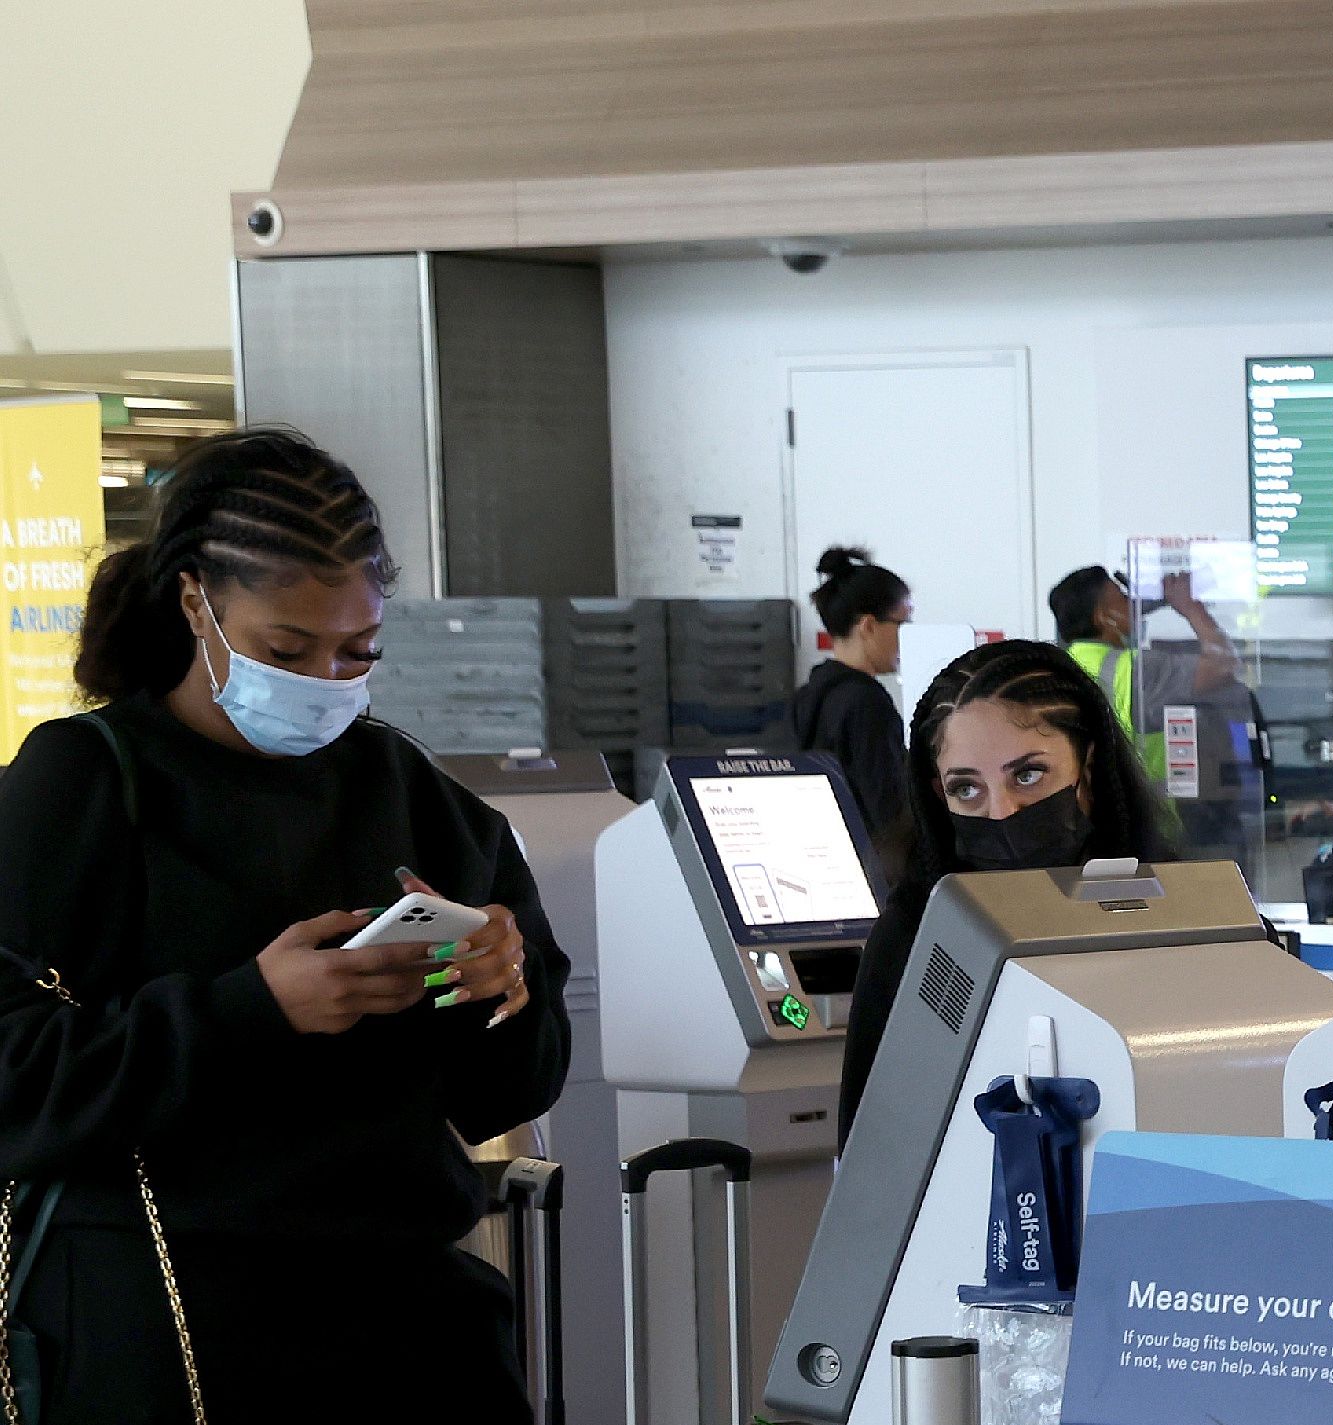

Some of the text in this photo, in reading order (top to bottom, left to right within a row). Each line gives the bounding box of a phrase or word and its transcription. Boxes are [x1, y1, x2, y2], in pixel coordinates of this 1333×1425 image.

[17, 517, 82, 547] BREATH
[3, 559, 85, 592] OF FRESH
[1016, 1191, 1040, 1272] Self-tag
[1127, 1280, 1249, 1315] Measure
[1257, 1294, 1322, 1323] your
[1122, 1329, 1135, 1345] If
[1137, 1333, 1169, 1349] your
[1172, 1331, 1200, 1352] bag
[1203, 1334, 1227, 1351] fits
[1229, 1335, 1279, 1357] below,
[1282, 1342, 1328, 1358] you're
[1119, 1351, 1132, 1366] If
[1134, 1354, 1162, 1371] not,
[1166, 1357, 1188, 1370] we
[1190, 1359, 1217, 1373] can
[1220, 1357, 1256, 1377] help.
[1258, 1360, 1288, 1378] Ask
[1290, 1366, 1319, 1382] any
